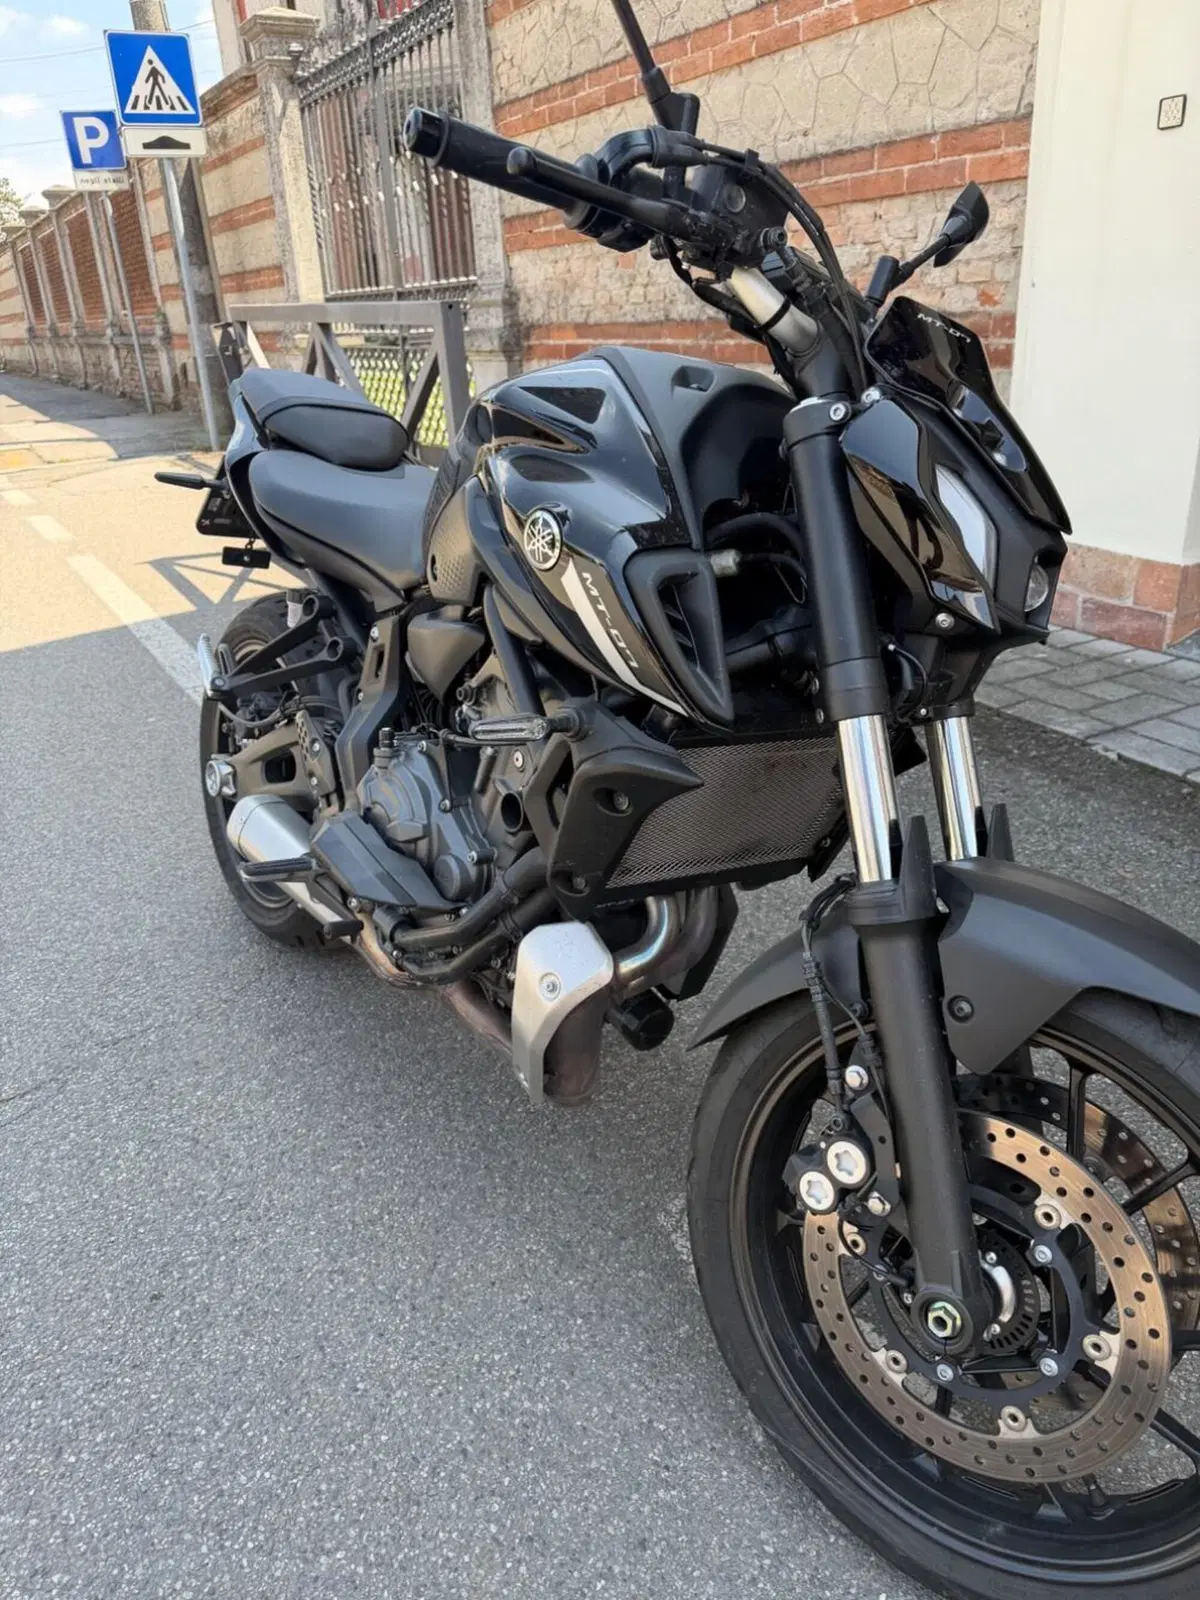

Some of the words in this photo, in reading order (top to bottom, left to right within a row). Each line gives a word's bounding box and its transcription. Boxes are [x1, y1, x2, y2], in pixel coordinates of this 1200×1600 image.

[73, 117, 110, 164] P
[917, 313, 971, 343] MT-07
[582, 572, 639, 668] MT-07
